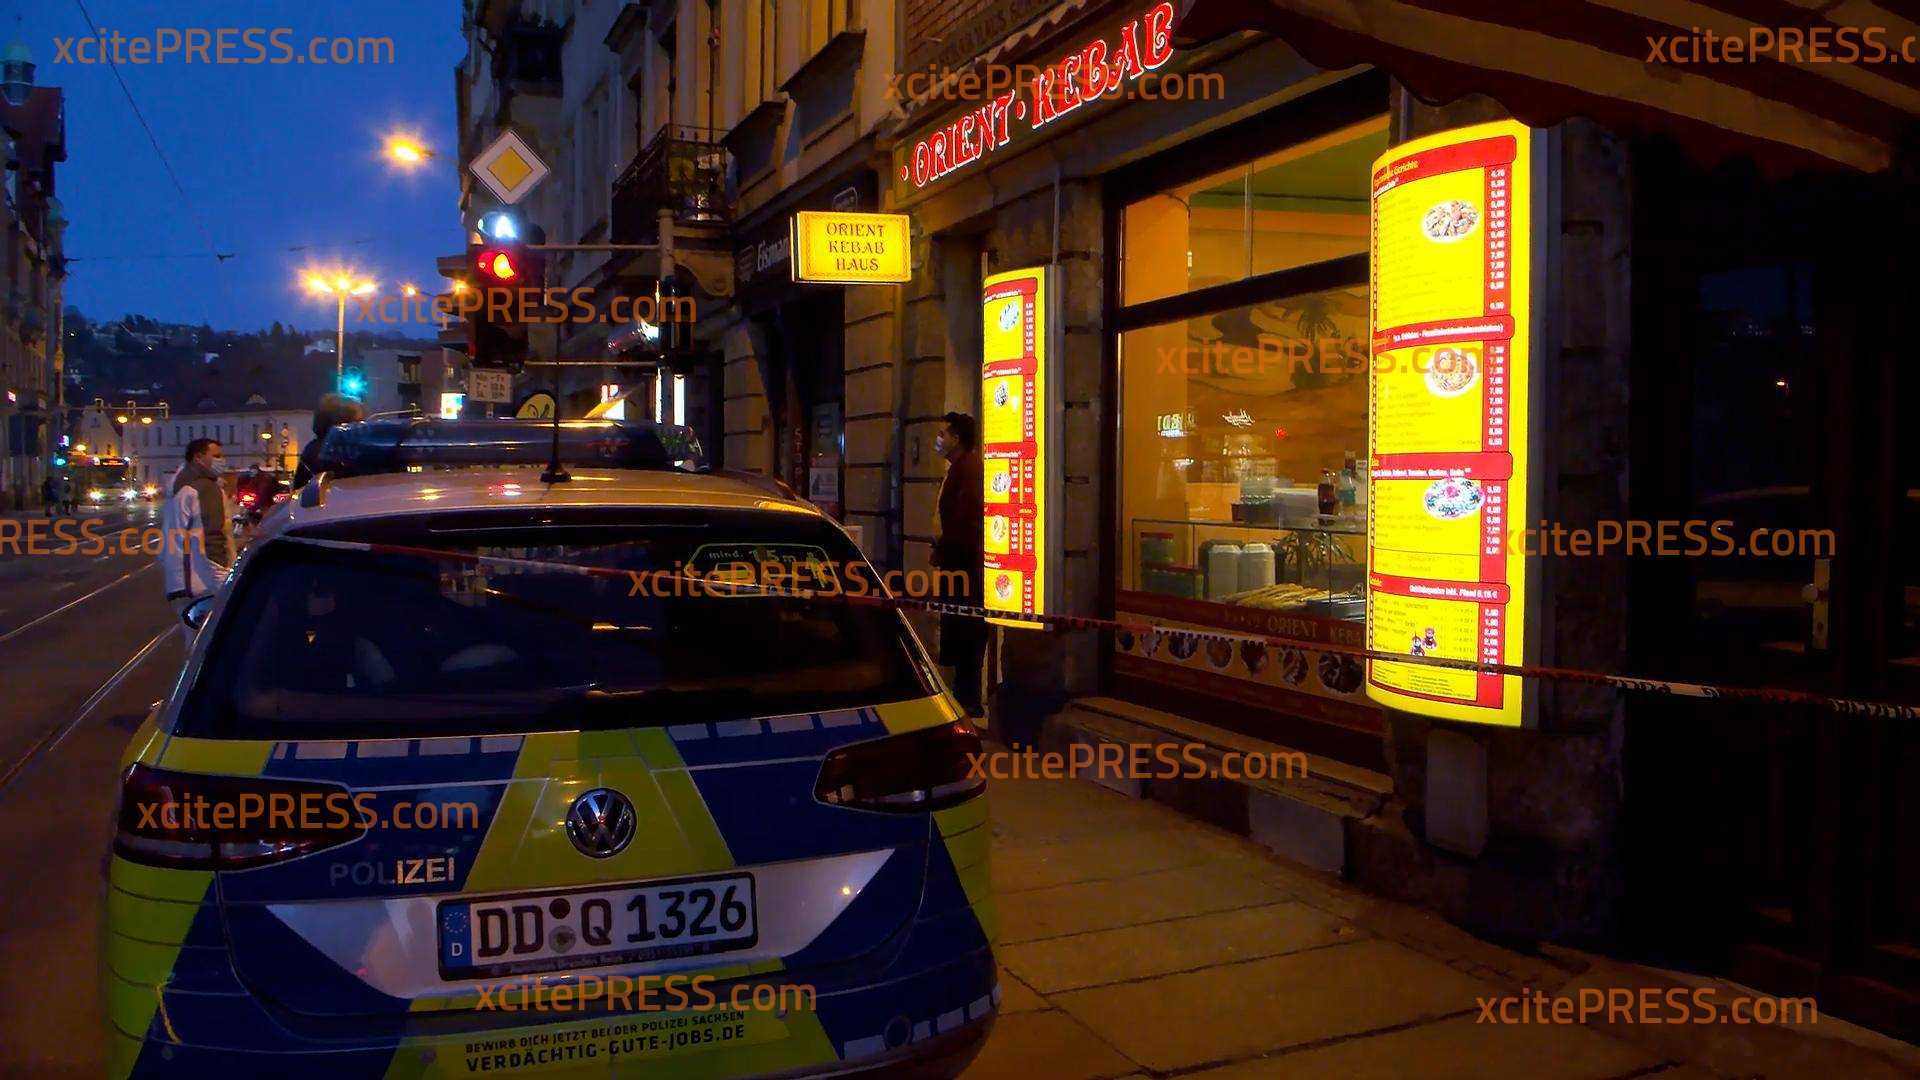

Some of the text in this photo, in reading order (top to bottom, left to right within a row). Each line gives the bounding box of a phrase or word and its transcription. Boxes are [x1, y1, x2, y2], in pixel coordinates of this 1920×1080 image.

[912, 89, 1016, 188] ORIENT
[1032, 1, 1174, 129] KEBAB
[826, 222, 885, 237] ORIENT
[828, 240, 885, 255] KEBAB
[836, 257, 879, 272] HAUS
[329, 857, 456, 887] POLIZEI
[477, 885, 747, 957] DD Q 1326
[451, 942, 463, 957] D
[465, 1010, 745, 1053] BEWIRB DICH JETZT BEI DER POLIZEI SACHSEN
